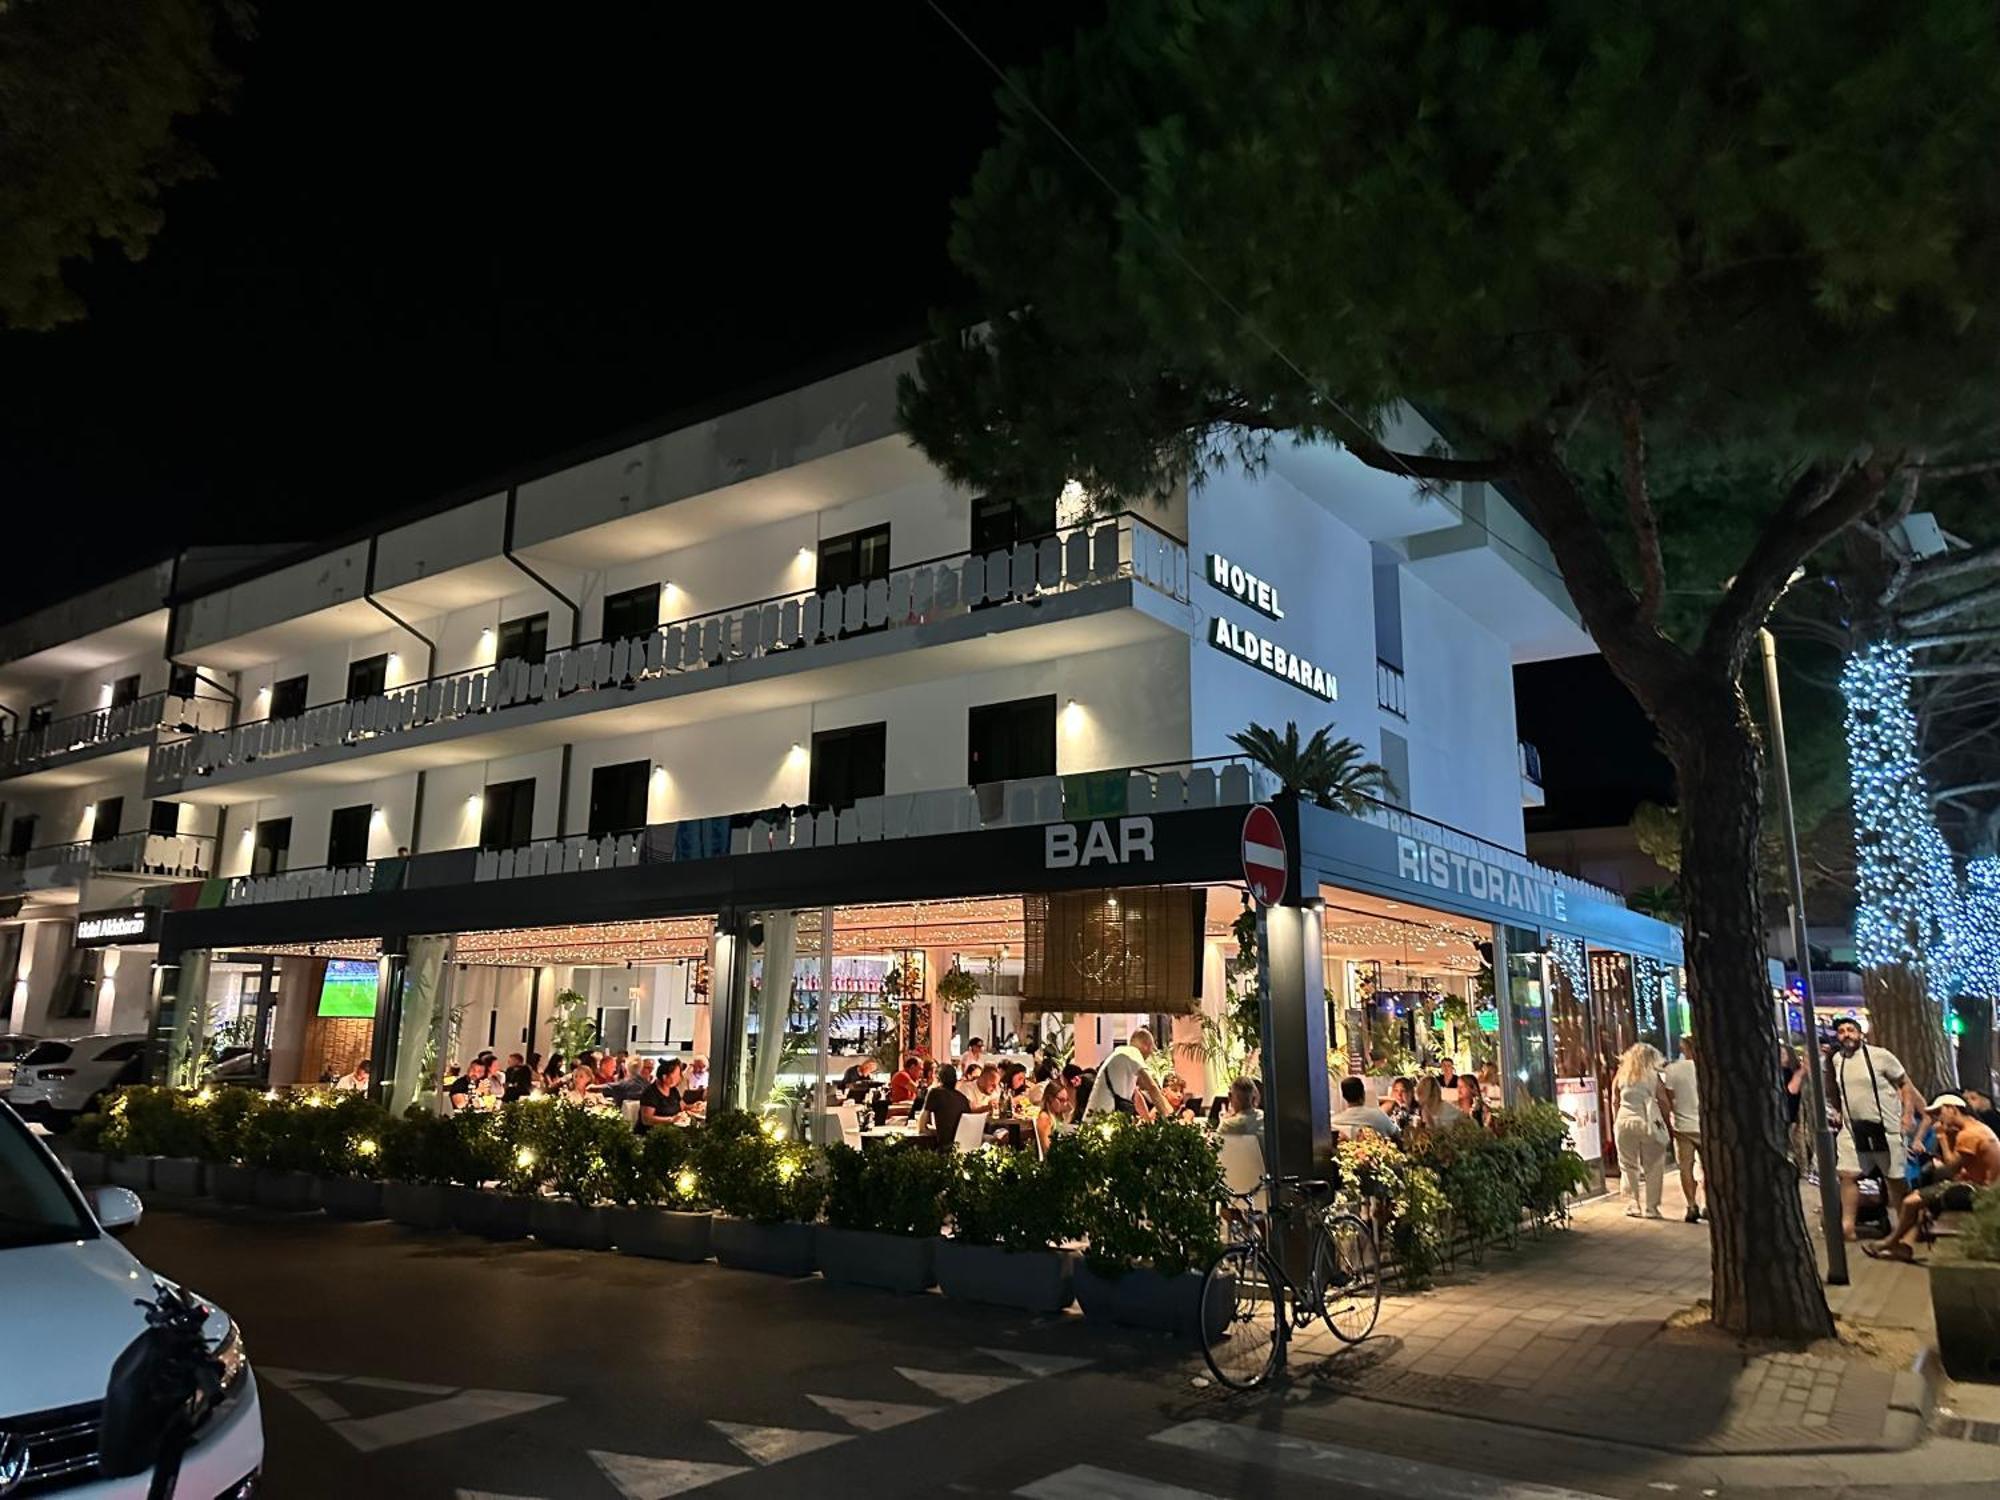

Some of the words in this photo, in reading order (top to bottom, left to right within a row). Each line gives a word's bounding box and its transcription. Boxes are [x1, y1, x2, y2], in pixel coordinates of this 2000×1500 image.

[1213, 553, 1285, 619] HOTEL
[1215, 616, 1338, 701] ALDEBARAN
[1045, 816, 1154, 869] BAR
[1397, 835, 1568, 923] RISTORANTE
[78, 920, 101, 938] Hotel
[101, 917, 145, 936] Aldebaran
